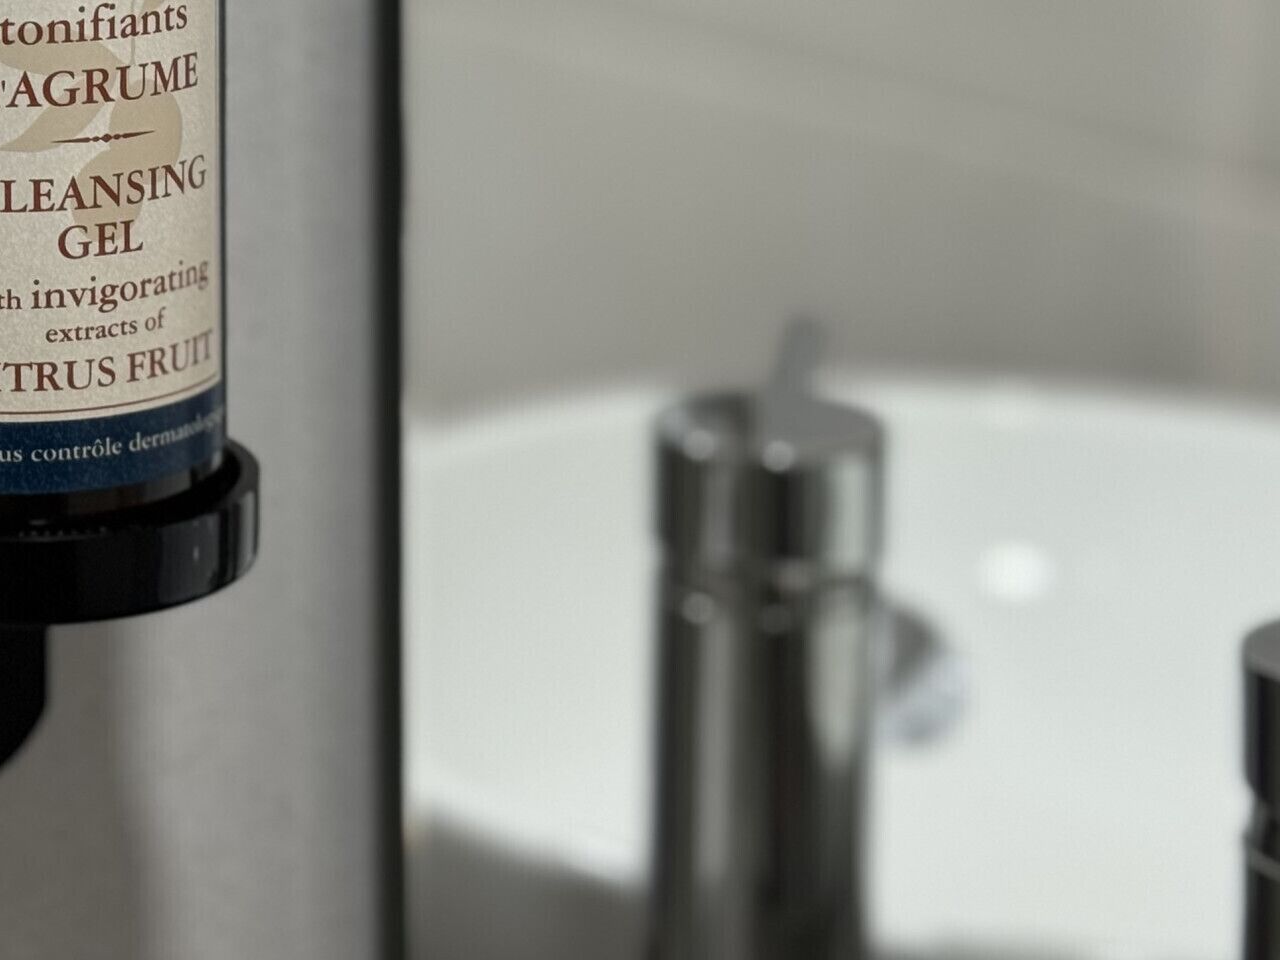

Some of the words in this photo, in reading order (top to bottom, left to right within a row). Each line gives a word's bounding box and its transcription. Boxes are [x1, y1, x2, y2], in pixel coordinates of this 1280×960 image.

[0, 2, 188, 46] tonifiants
[58, 219, 144, 260] GEL
[31, 260, 209, 313] invigorating
[45, 319, 138, 344] extracts
[145, 306, 167, 332] of
[126, 328, 213, 383] FRUIT
[31, 436, 122, 462] contrôle
